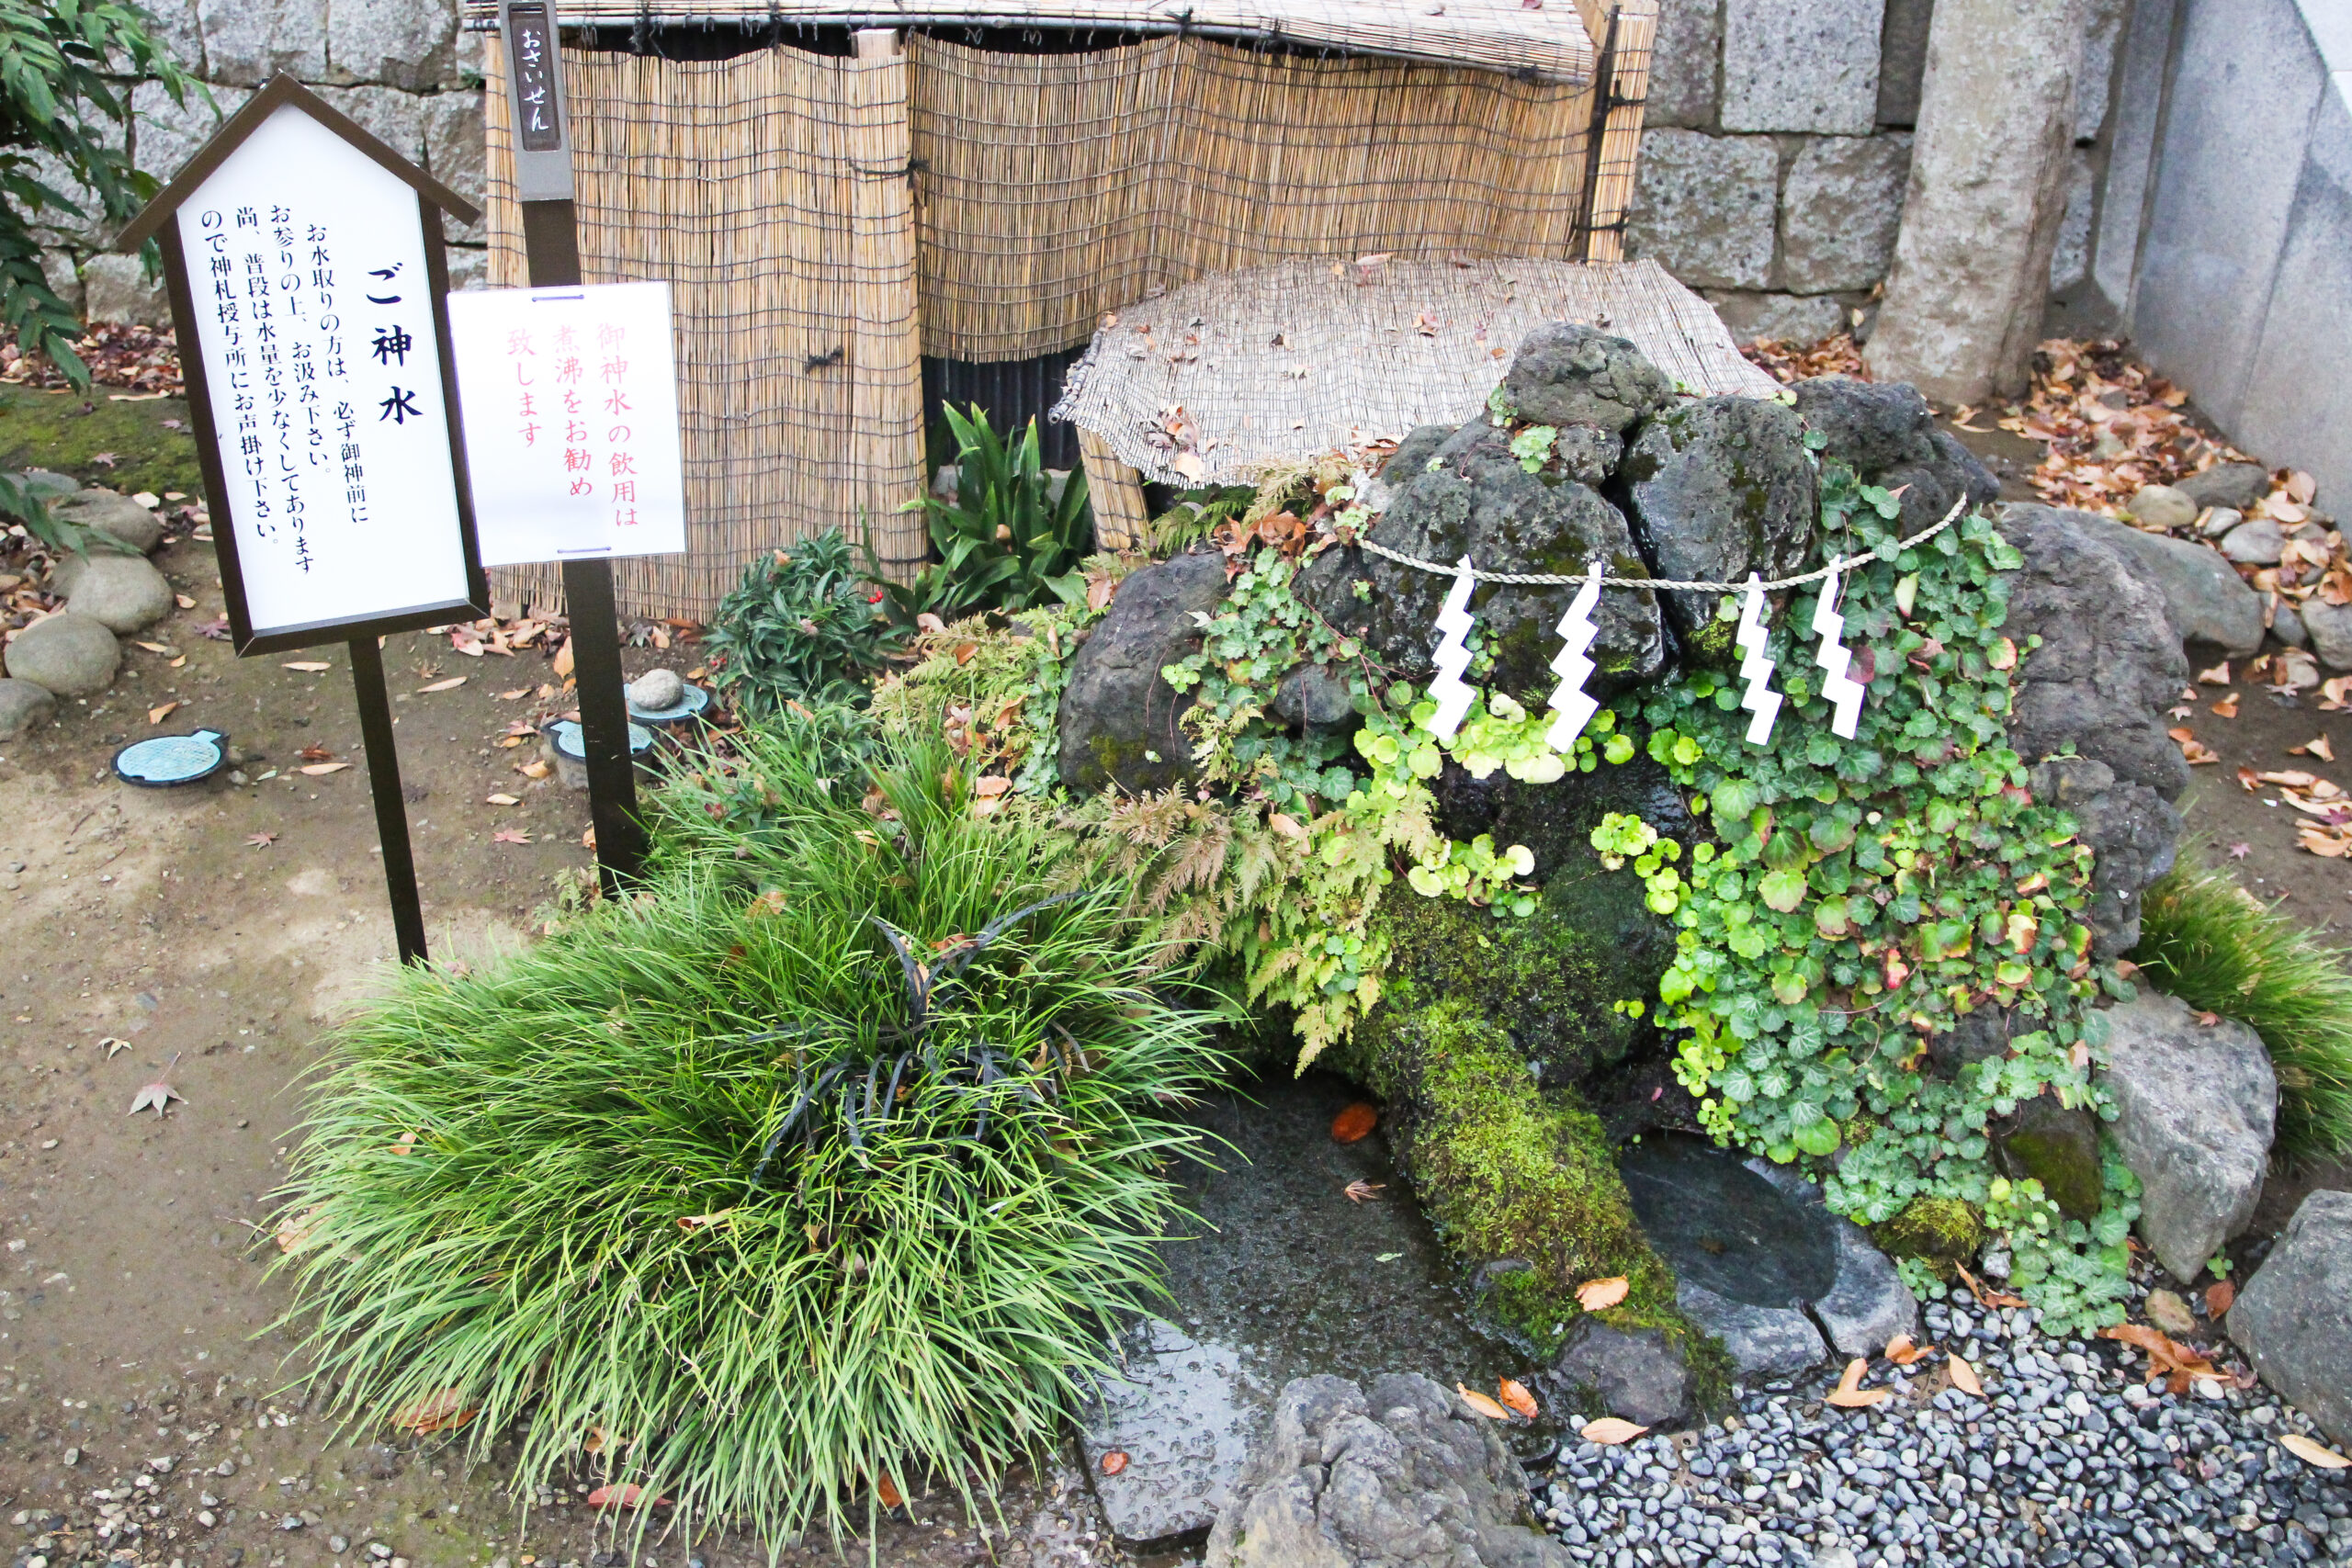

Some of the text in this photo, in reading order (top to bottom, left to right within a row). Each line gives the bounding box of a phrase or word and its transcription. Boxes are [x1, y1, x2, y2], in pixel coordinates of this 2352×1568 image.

[522, 29, 548, 131] おさいせん
[201, 209, 278, 545] ので神札授与所にお声掛け下さい。
[366, 262, 424, 425] ご神水
[507, 328, 542, 447] 致します
[553, 324, 593, 497] 煮沸をお勧め
[596, 322, 639, 527] 御神水の飲用は
